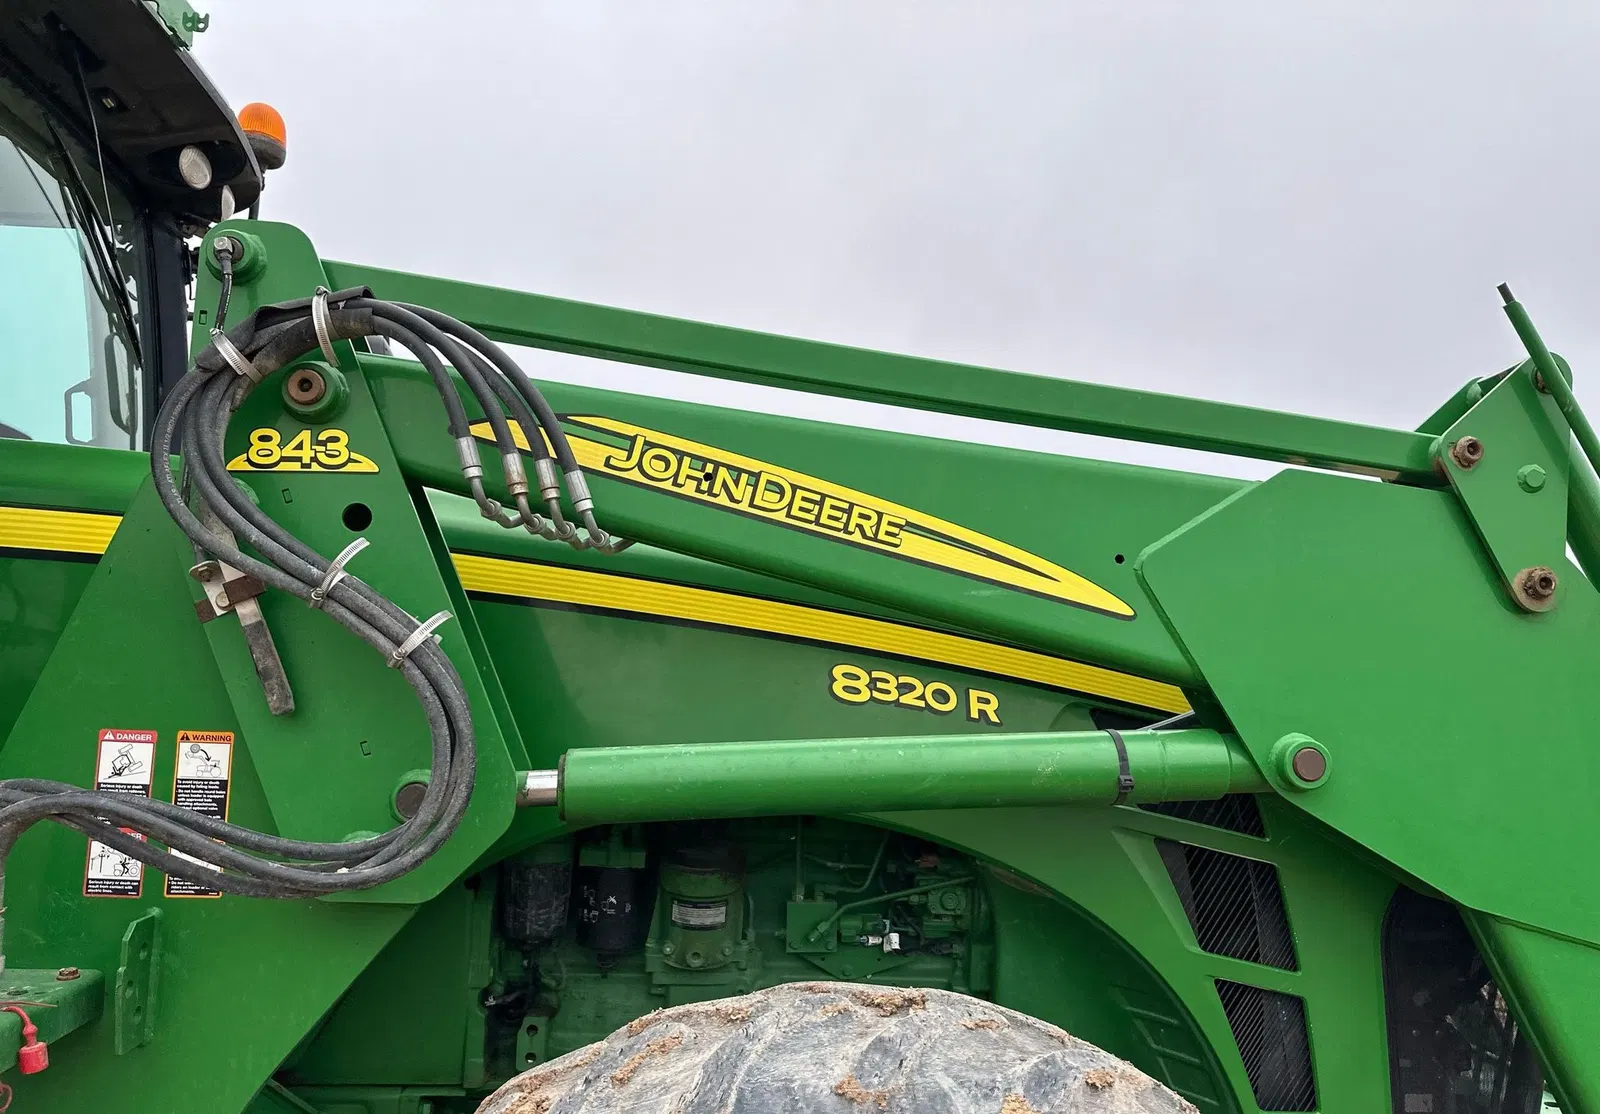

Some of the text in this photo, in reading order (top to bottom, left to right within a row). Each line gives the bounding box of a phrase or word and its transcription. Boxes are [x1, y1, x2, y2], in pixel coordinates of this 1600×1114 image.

[247, 428, 350, 467] 843
[606, 434, 906, 547] JOHN DEERE
[829, 664, 1002, 726] 8320 R
[116, 733, 152, 741] DANGER
